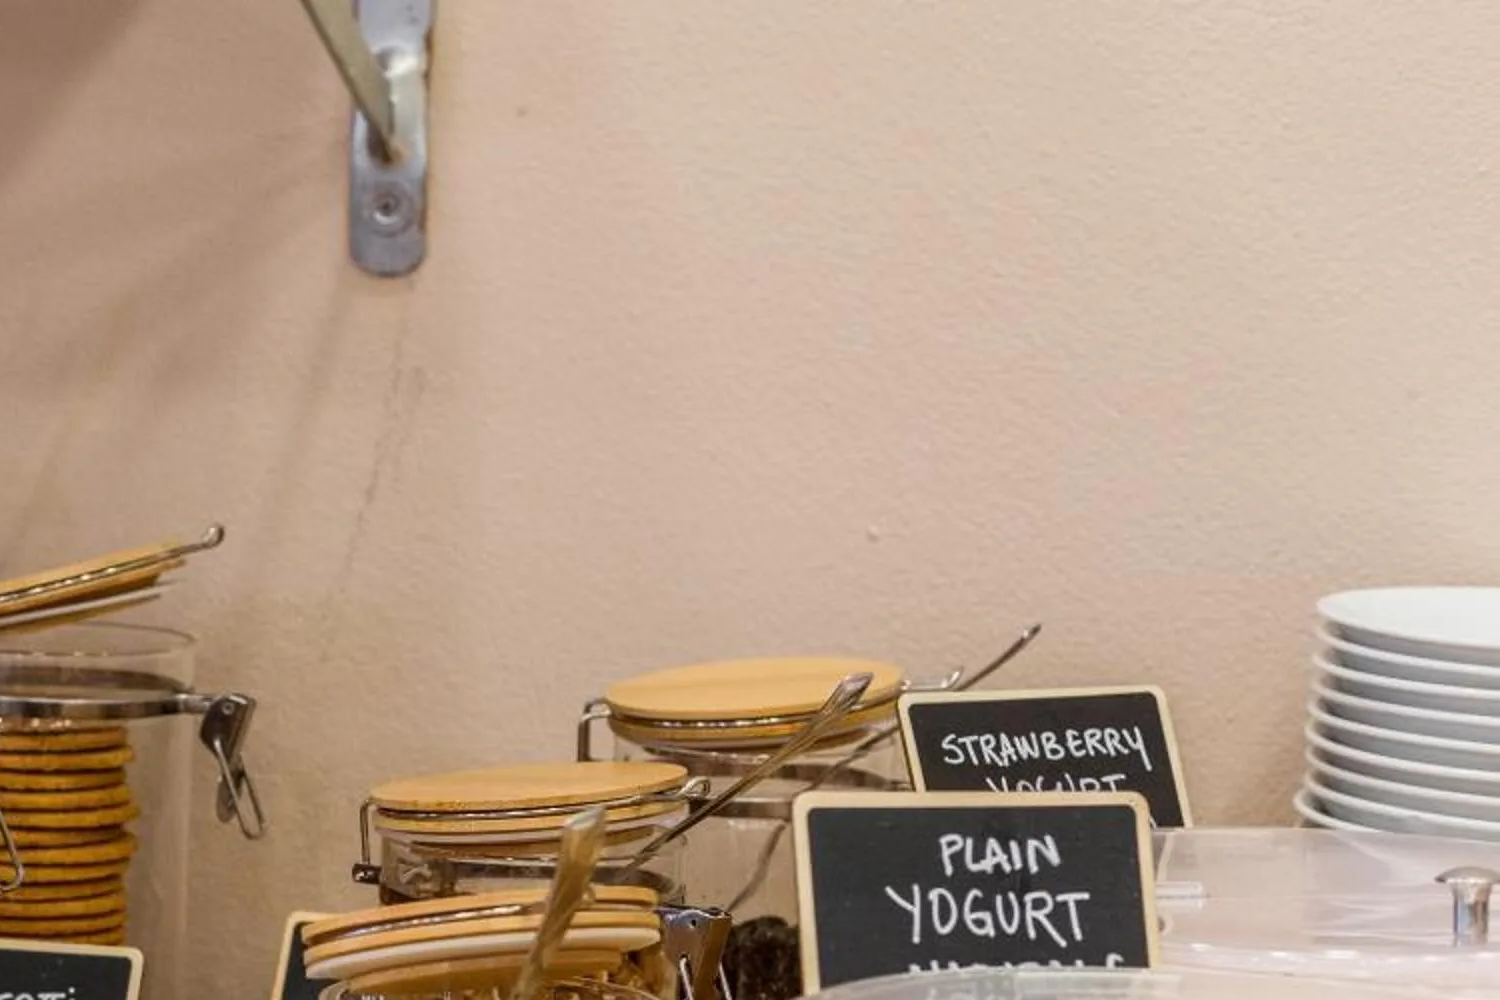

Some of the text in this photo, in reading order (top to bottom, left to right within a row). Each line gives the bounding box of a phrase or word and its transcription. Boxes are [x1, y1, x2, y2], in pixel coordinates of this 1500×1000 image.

[941, 726, 1153, 772] STRAWBERRY
[939, 833, 1062, 876] PLAIN
[885, 883, 1091, 948] YOGURT
